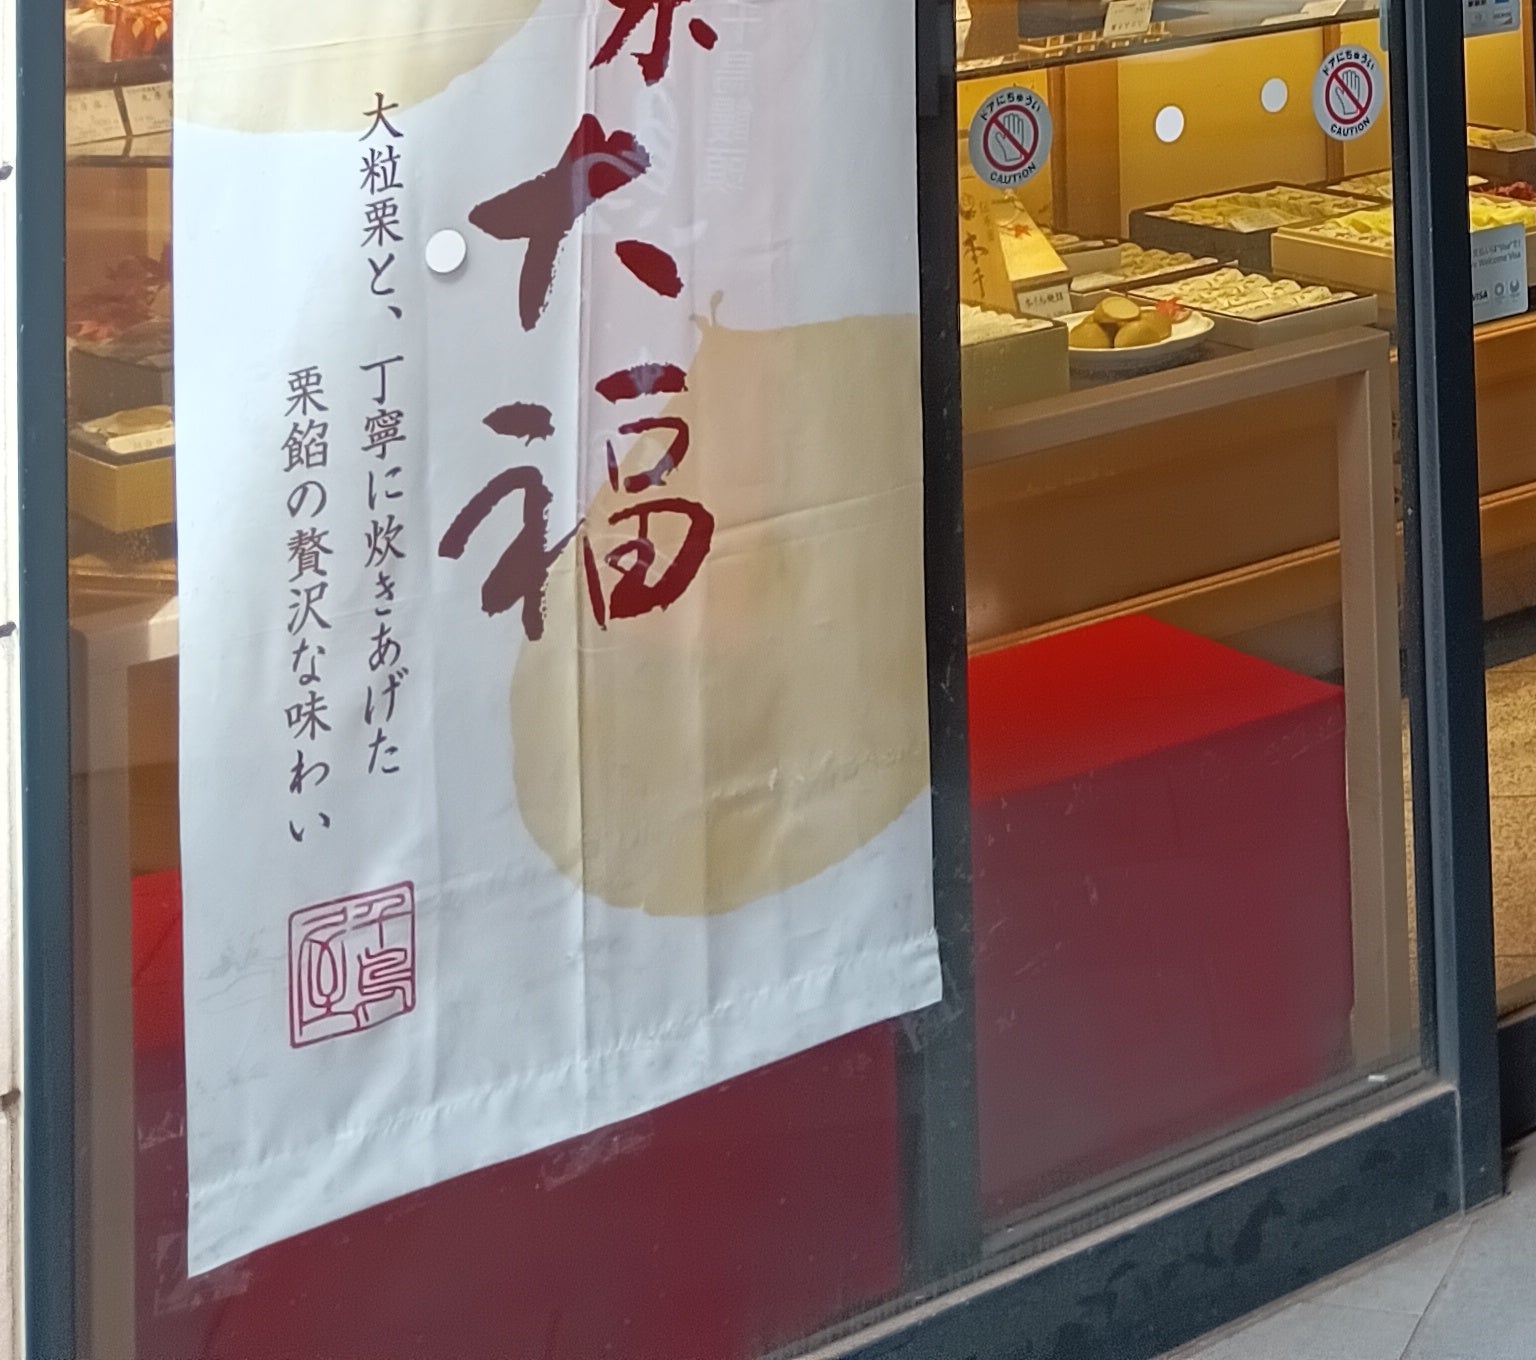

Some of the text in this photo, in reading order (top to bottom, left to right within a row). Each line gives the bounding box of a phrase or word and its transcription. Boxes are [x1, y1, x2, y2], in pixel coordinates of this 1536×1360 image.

[1322, 49, 1376, 77] ドアにちゅうい
[980, 91, 1041, 121] ドアにちゅうい
[1330, 116, 1371, 137] CAUTION
[990, 161, 1037, 185] CAUTION
[280, 366, 333, 844] 栗餡の贅沢な味わい
